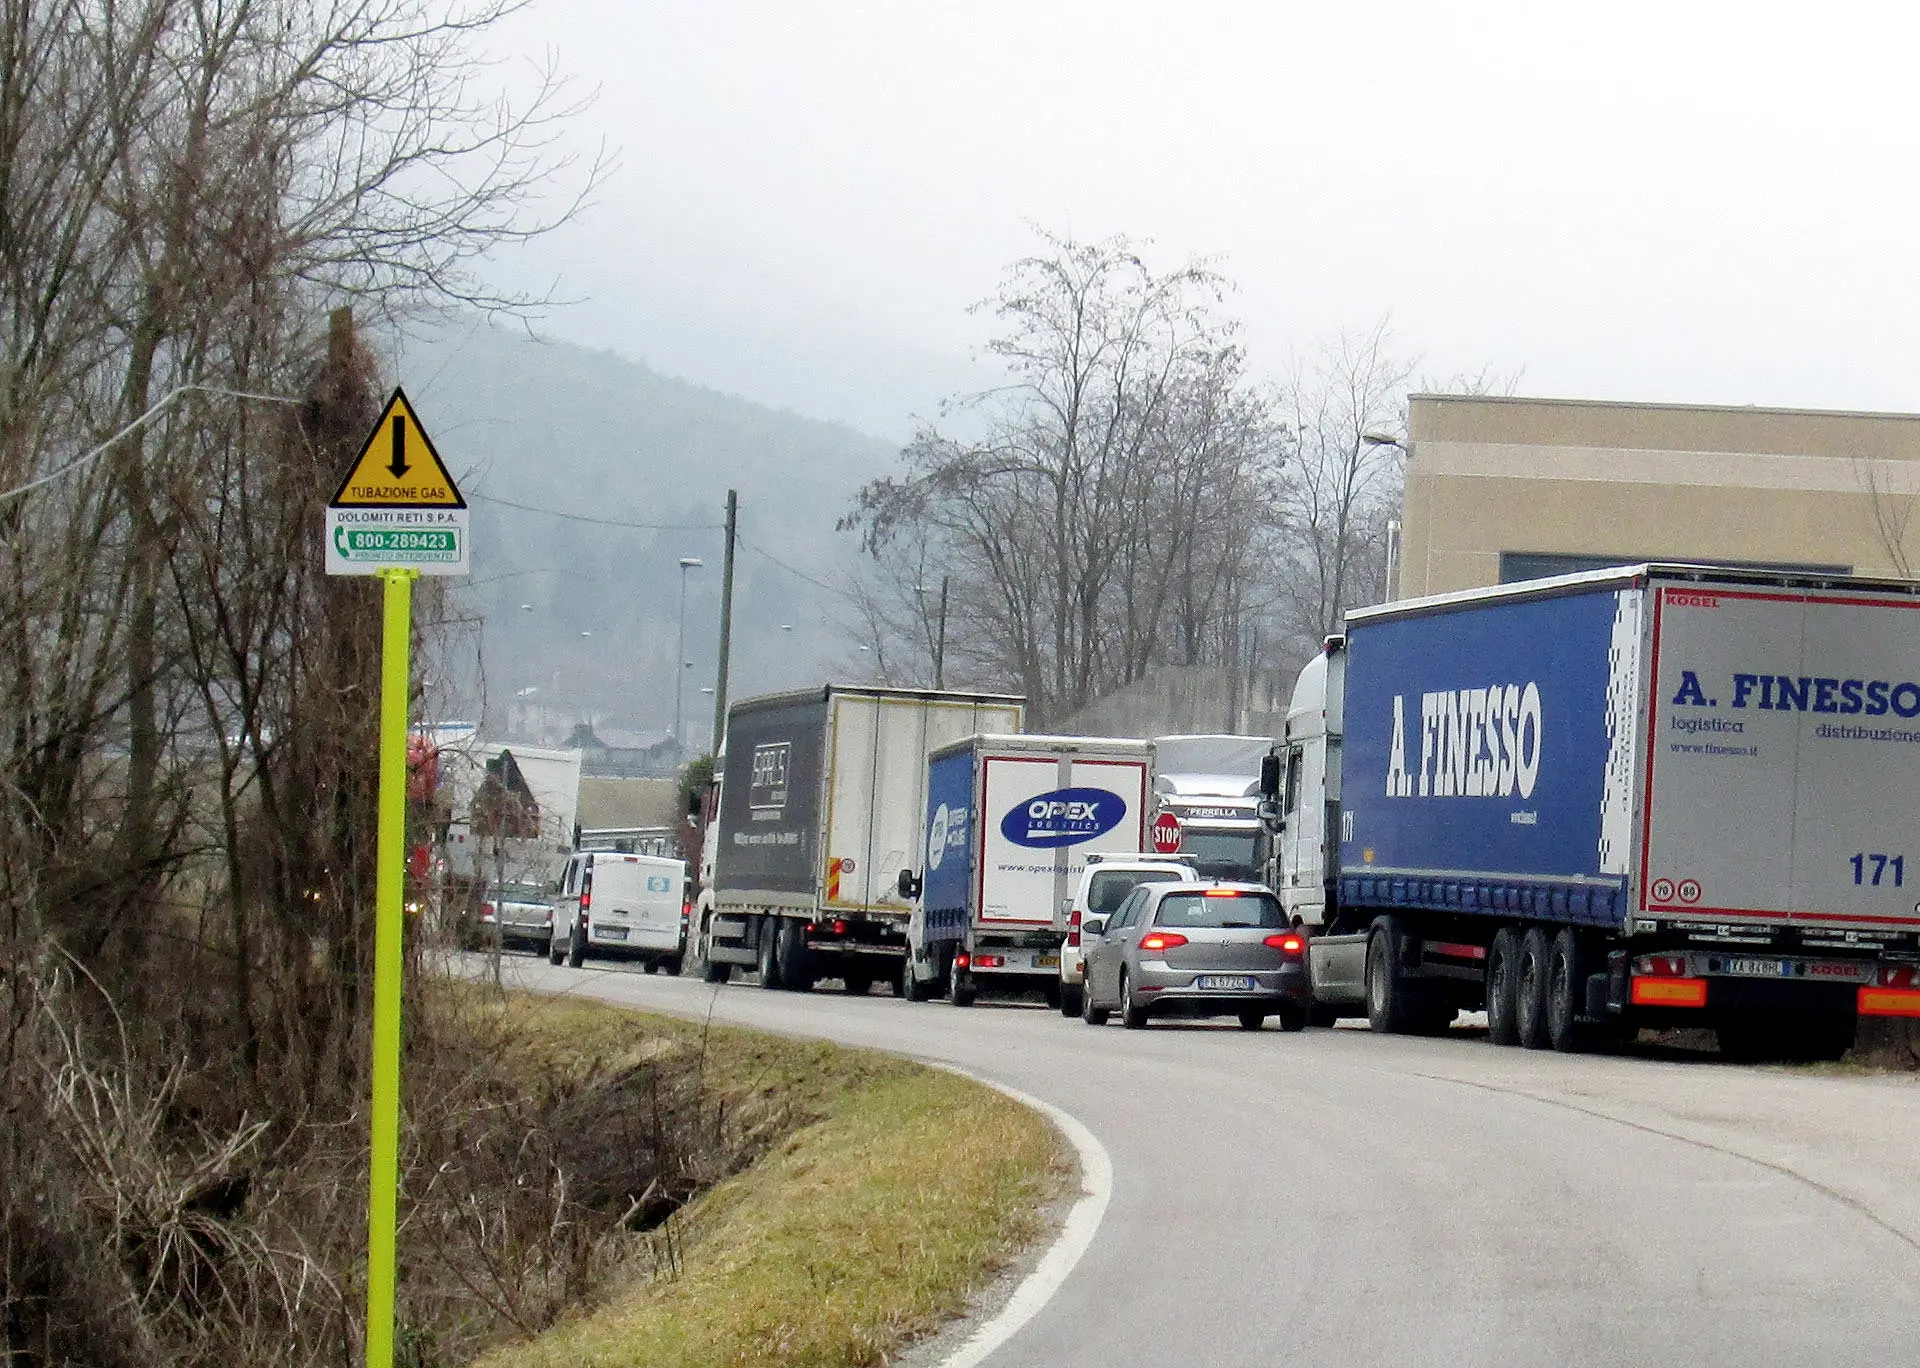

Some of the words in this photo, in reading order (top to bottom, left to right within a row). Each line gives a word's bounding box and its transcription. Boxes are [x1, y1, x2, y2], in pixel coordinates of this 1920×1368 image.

[350, 487, 417, 499] TUBAZIONE
[420, 487, 446, 499] GAS
[337, 512, 393, 523] DOLOMITI
[396, 513, 423, 523] RETI
[354, 533, 448, 549] 800-289423
[1672, 671, 1717, 707] A.
[1732, 673, 1920, 718] FINESSO
[1671, 715, 1744, 735] logistica
[1815, 723, 1920, 743] distribuzione
[1386, 694, 1413, 798] A.
[1419, 682, 1542, 800] FINESSO
[1670, 742, 1759, 758] www.finesso.it
[1028, 800, 1100, 821] OPEX
[1154, 826, 1179, 844] STOP
[1849, 852, 1905, 888] 171
[1657, 885, 1669, 897] 70
